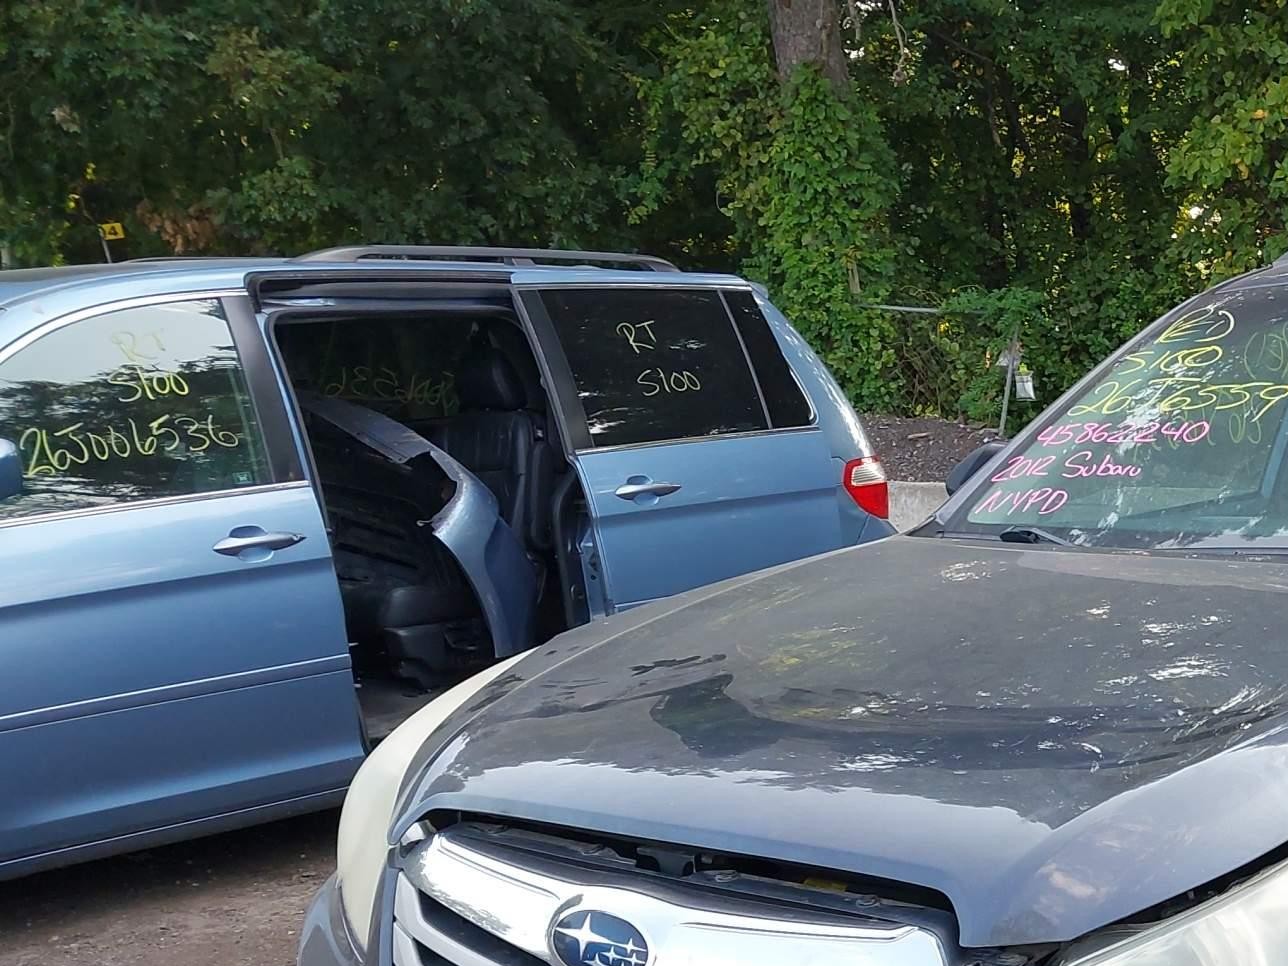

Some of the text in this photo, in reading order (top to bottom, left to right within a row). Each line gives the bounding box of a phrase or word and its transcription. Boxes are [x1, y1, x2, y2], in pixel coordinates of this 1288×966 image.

[615, 319, 657, 354] RT
[1037, 421, 1210, 447] 45862240
[1062, 451, 1142, 478] Subaru
[975, 487, 1068, 516] NYPD
